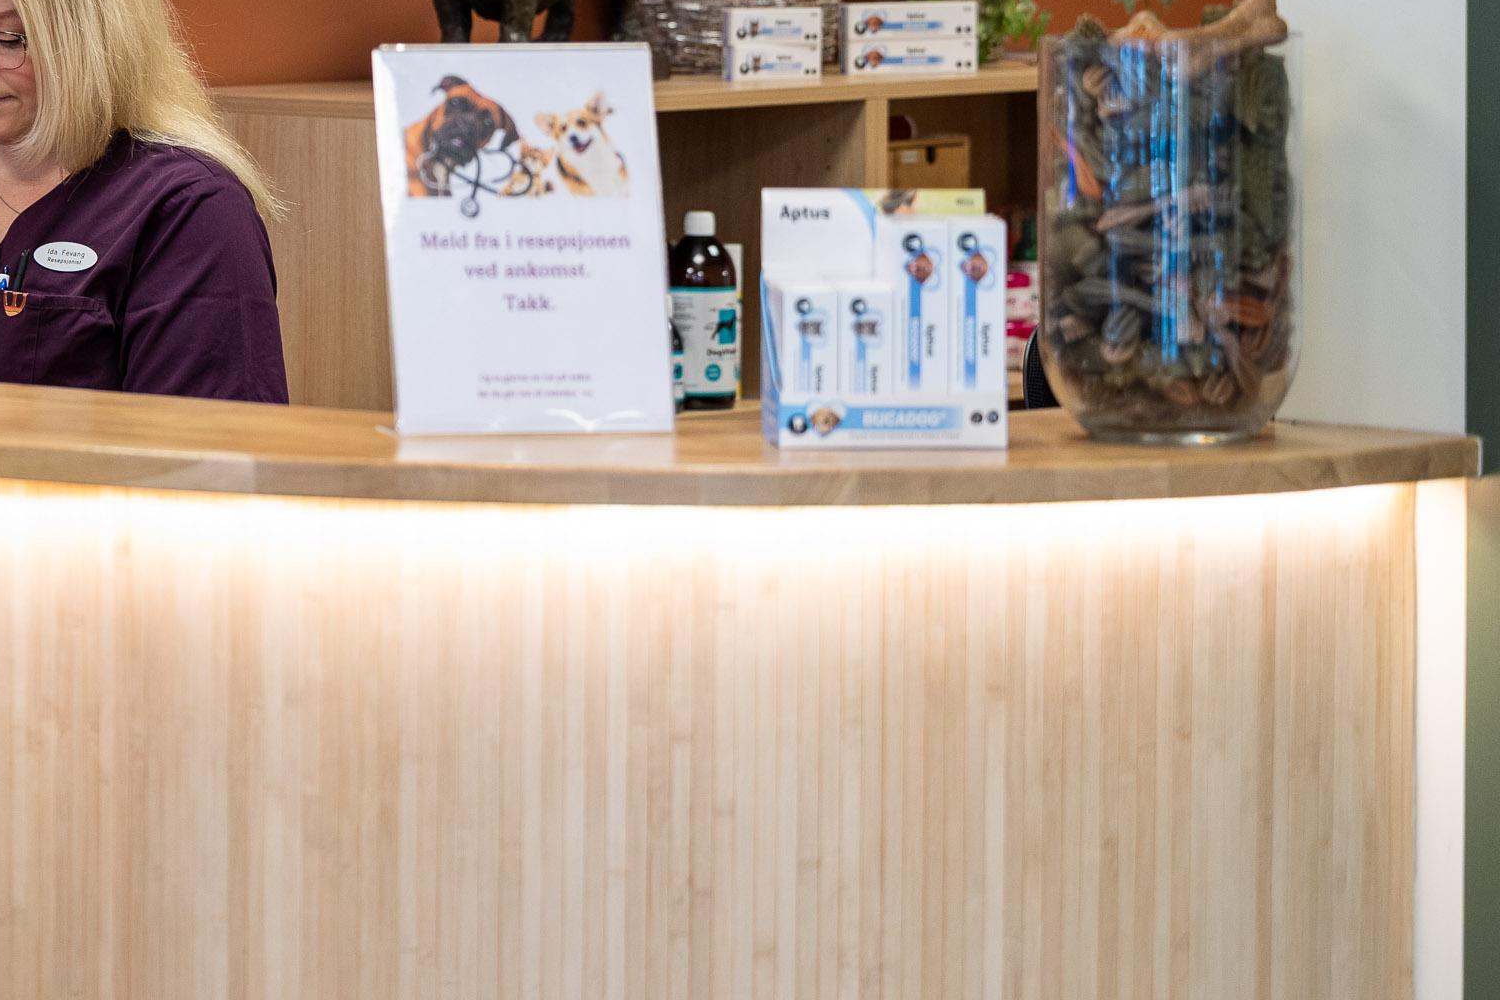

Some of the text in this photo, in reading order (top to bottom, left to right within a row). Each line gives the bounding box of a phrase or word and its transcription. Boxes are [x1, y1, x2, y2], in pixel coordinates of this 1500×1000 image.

[779, 205, 830, 223] Aptus
[421, 231, 631, 253] Meld fra i resepsjonen
[61, 249, 86, 259] Fevang
[464, 262, 591, 279] ved ankomst.
[504, 293, 556, 312] Takk.
